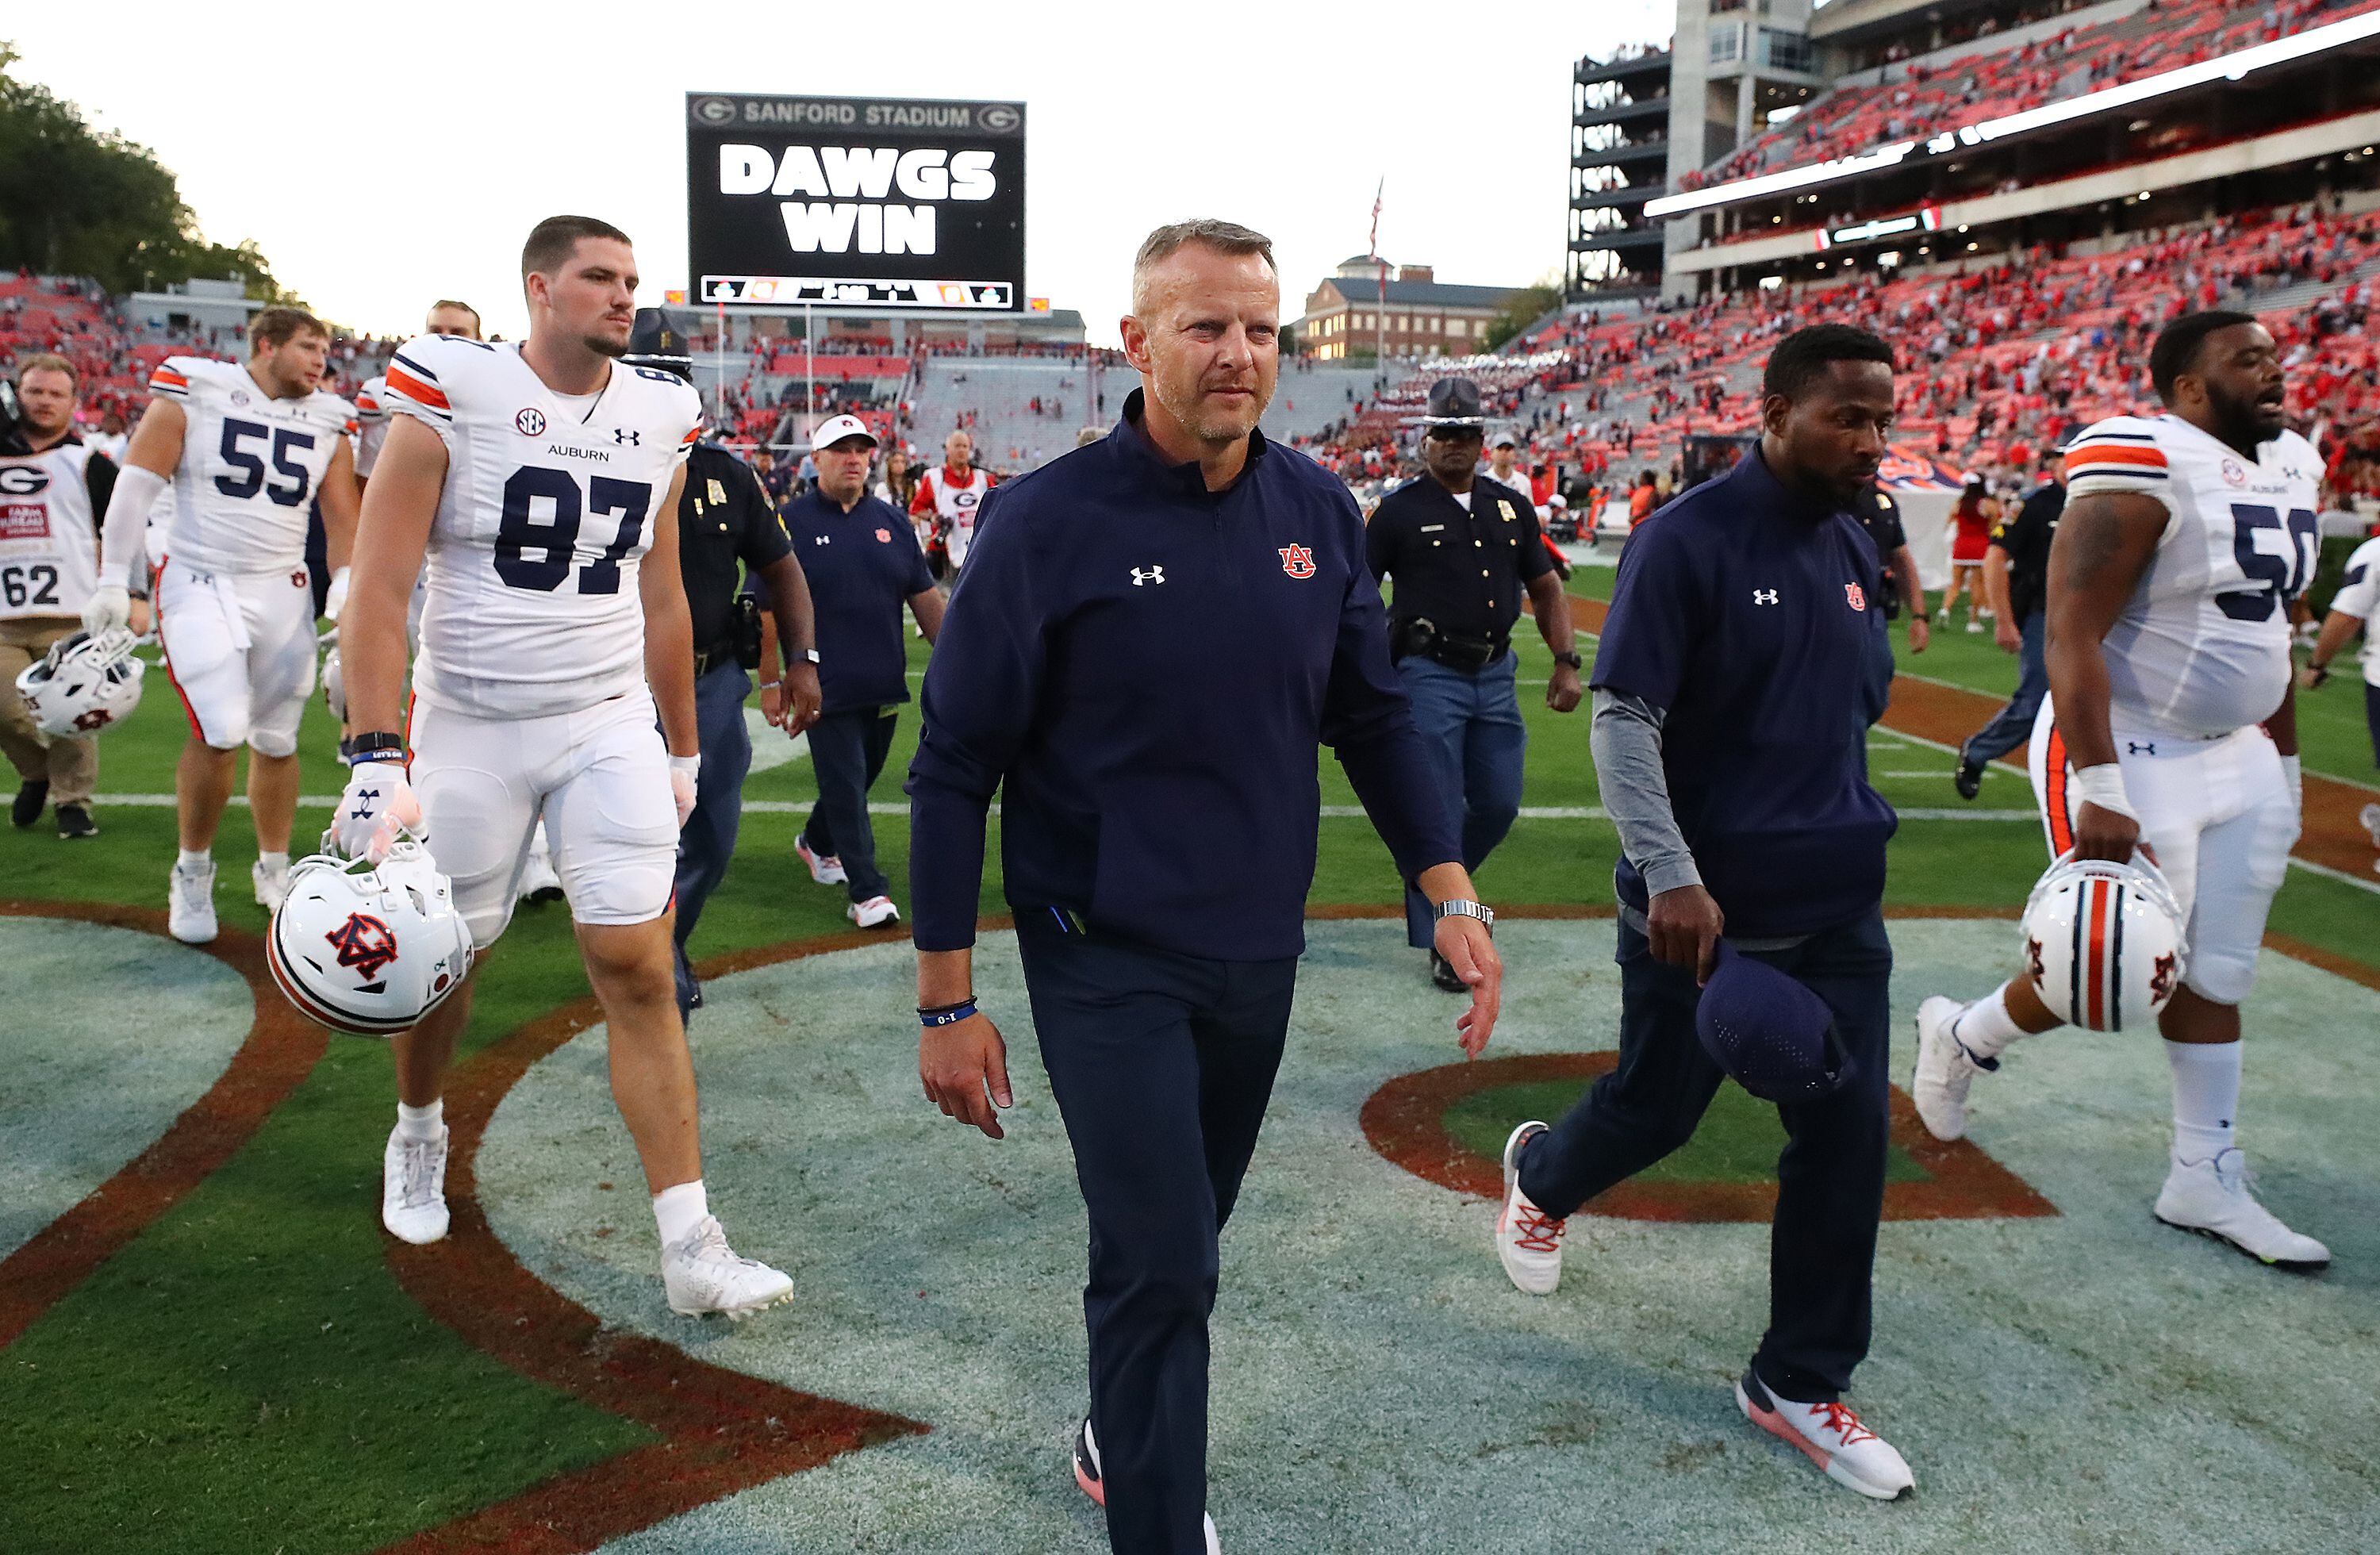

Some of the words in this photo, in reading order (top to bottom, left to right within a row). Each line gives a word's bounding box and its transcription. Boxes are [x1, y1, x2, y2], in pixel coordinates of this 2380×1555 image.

[743, 102, 856, 125] SANFORD
[865, 104, 970, 128] STADIUM
[719, 144, 996, 201] DAWGS
[779, 202, 937, 255] WIN
[518, 409, 545, 435] SEC
[214, 417, 316, 507] 55
[547, 444, 609, 463] AUBURN
[493, 465, 653, 594] 87
[2, 564, 60, 608] 62
